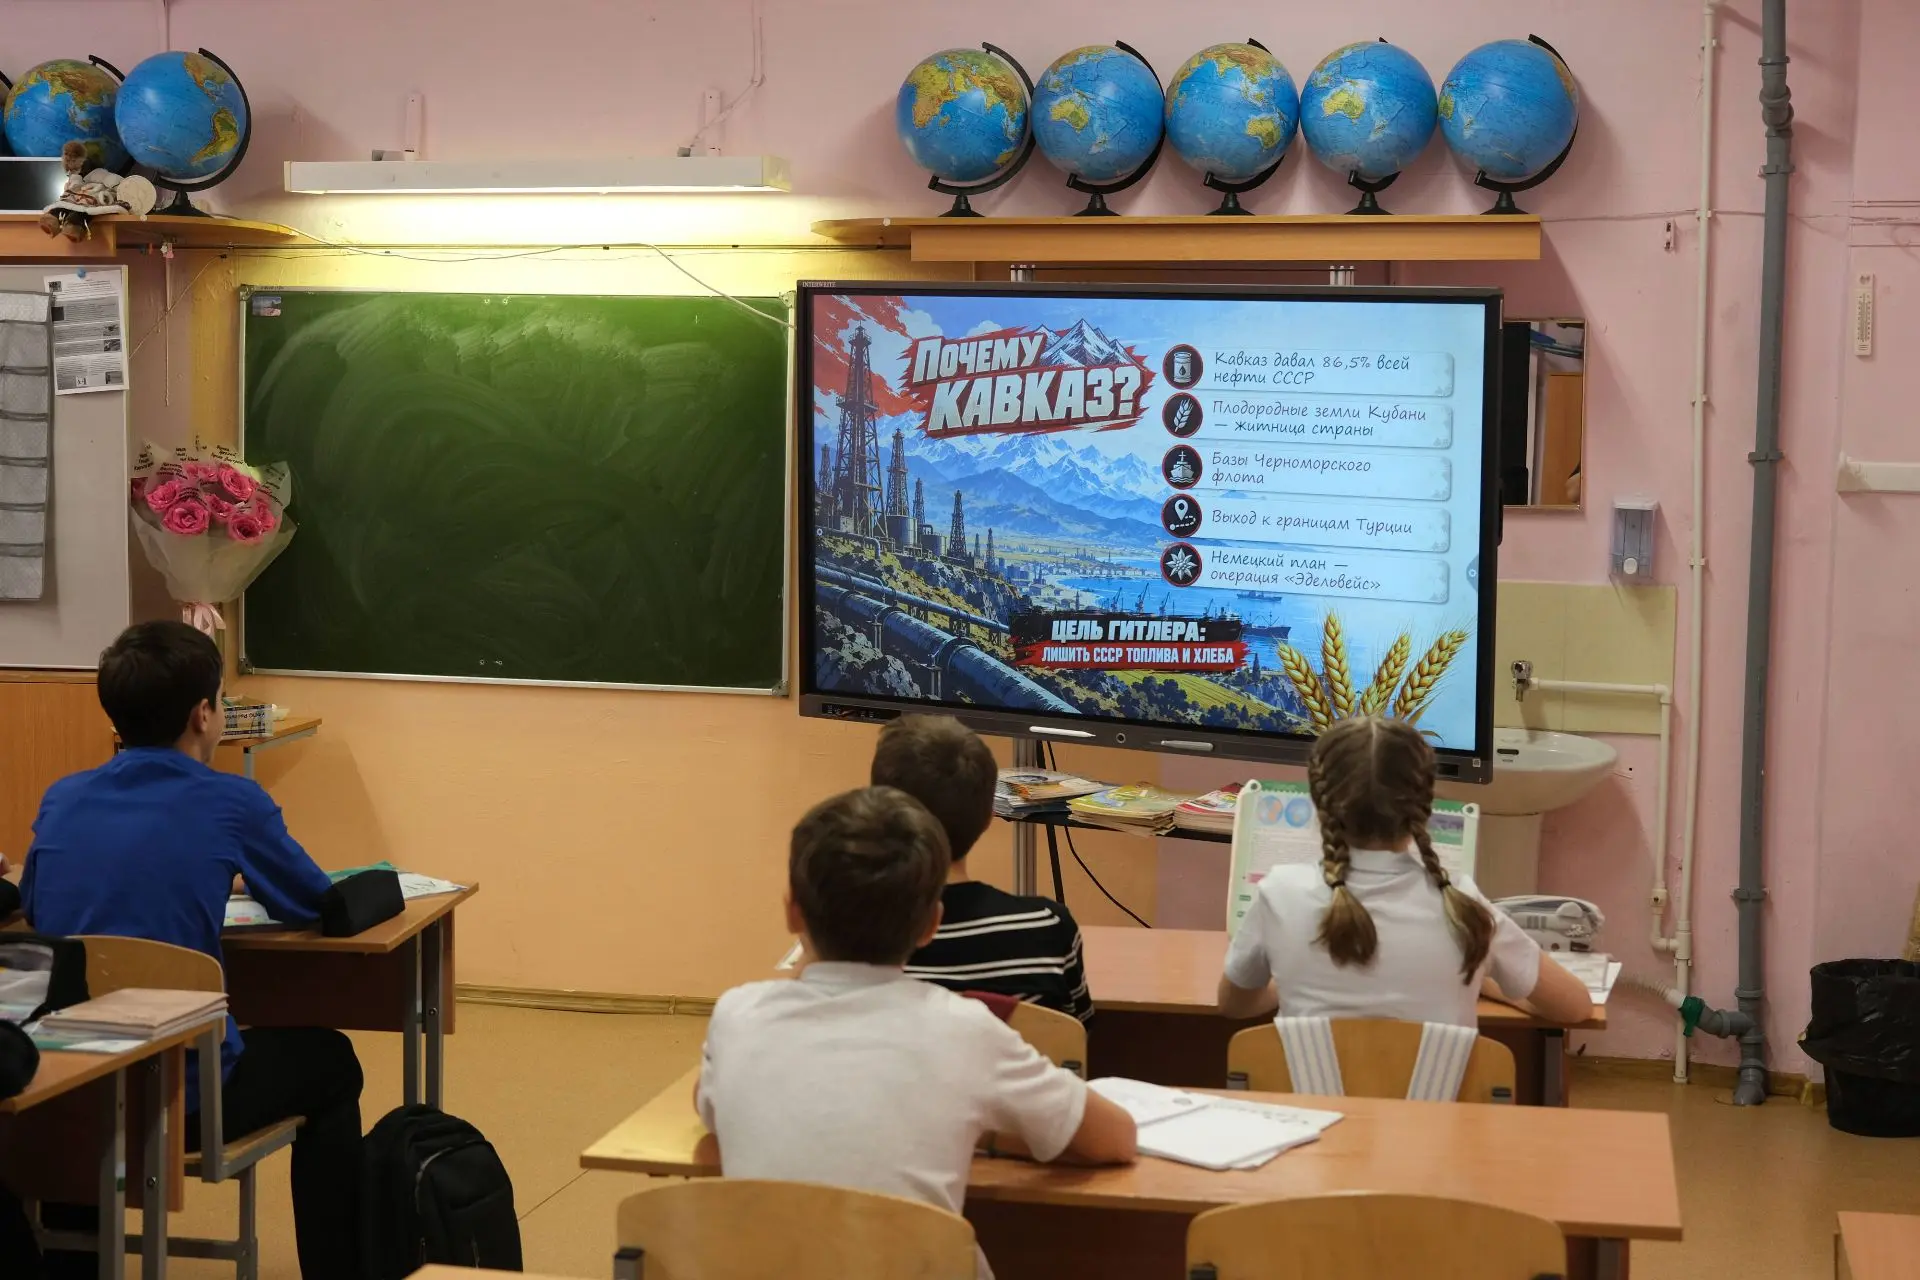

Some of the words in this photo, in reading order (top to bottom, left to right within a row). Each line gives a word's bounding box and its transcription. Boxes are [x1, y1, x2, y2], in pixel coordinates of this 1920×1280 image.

[1215, 351, 1267, 367] Кавказ
[1274, 351, 1314, 368] давал
[1322, 356, 1370, 370] 86,5%
[1377, 355, 1409, 370] всей
[1213, 370, 1266, 387] нефти
[1273, 372, 1314, 385] СССР
[928, 366, 1141, 431] КАВКАЗ?
[1213, 400, 1308, 418] Плодородные
[1315, 406, 1360, 419] земли
[1369, 407, 1426, 423] Кубани
[1235, 421, 1305, 436] житница
[1312, 423, 1373, 439] страны
[1212, 452, 1248, 466] Базы
[1255, 453, 1371, 473] Черноморского
[1212, 468, 1265, 486] флота
[1212, 509, 1256, 525] Выход
[1263, 515, 1270, 525] к
[1276, 515, 1349, 531] границам
[1356, 518, 1412, 535] Турции
[1211, 550, 1283, 568] Немецкий
[1291, 558, 1326, 569] план
[1211, 570, 1278, 585] операция
[1285, 572, 1380, 591] «Эдельвейс»
[1051, 620, 1103, 643] ЦЕЛЬ
[1108, 620, 1205, 642] ГИТЛЕРА:
[1042, 646, 1090, 662] ЛИШИТЬ
[1093, 647, 1122, 663] СССР
[1127, 648, 1178, 663] ТОПЛИВА
[1182, 648, 1190, 663] И
[1194, 648, 1233, 664] ХЛЕБА
